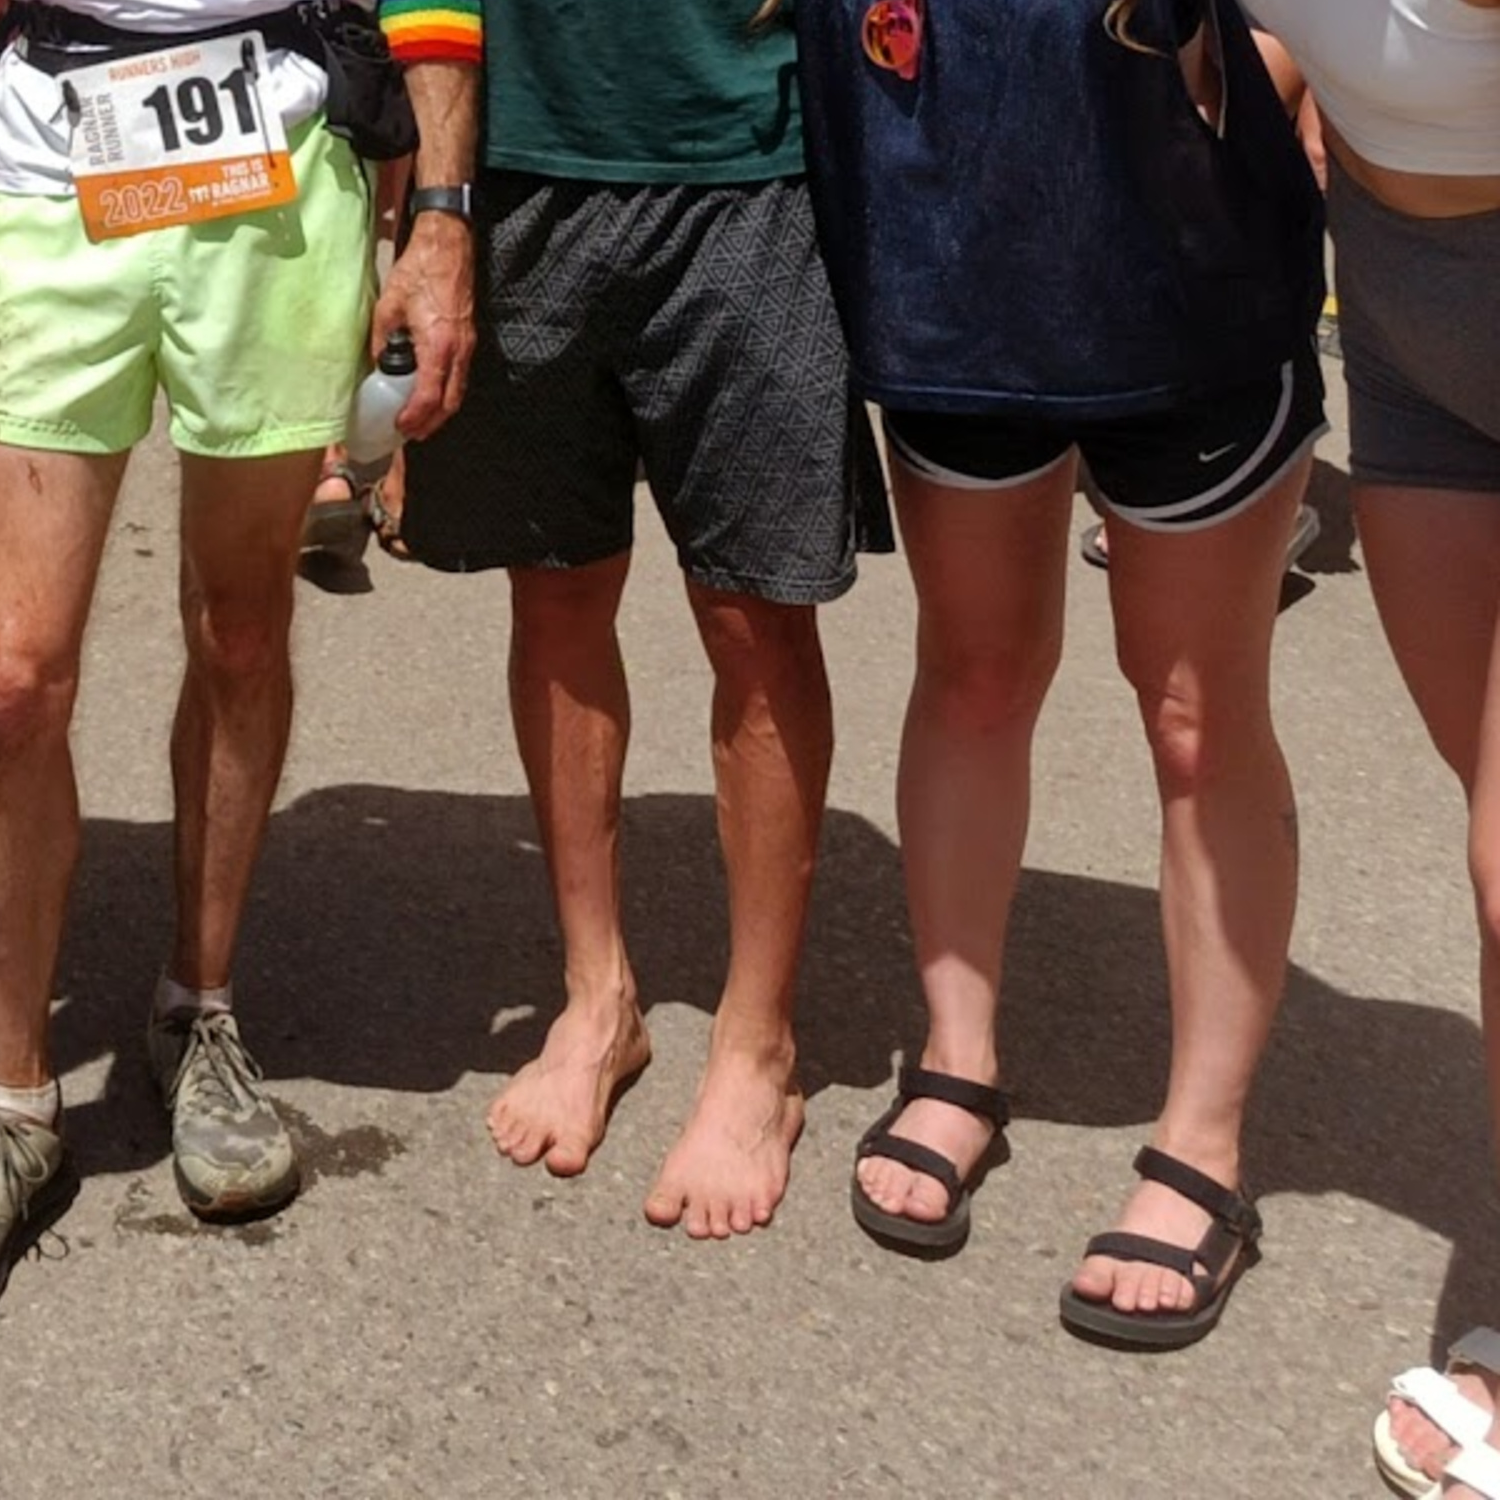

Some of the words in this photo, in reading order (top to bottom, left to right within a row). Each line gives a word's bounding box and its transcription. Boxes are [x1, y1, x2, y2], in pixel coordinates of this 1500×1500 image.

[97, 92, 124, 162] RUNNER
[142, 68, 257, 152] 191
[100, 176, 188, 229] 2022
[211, 171, 270, 199] RAGNAR
